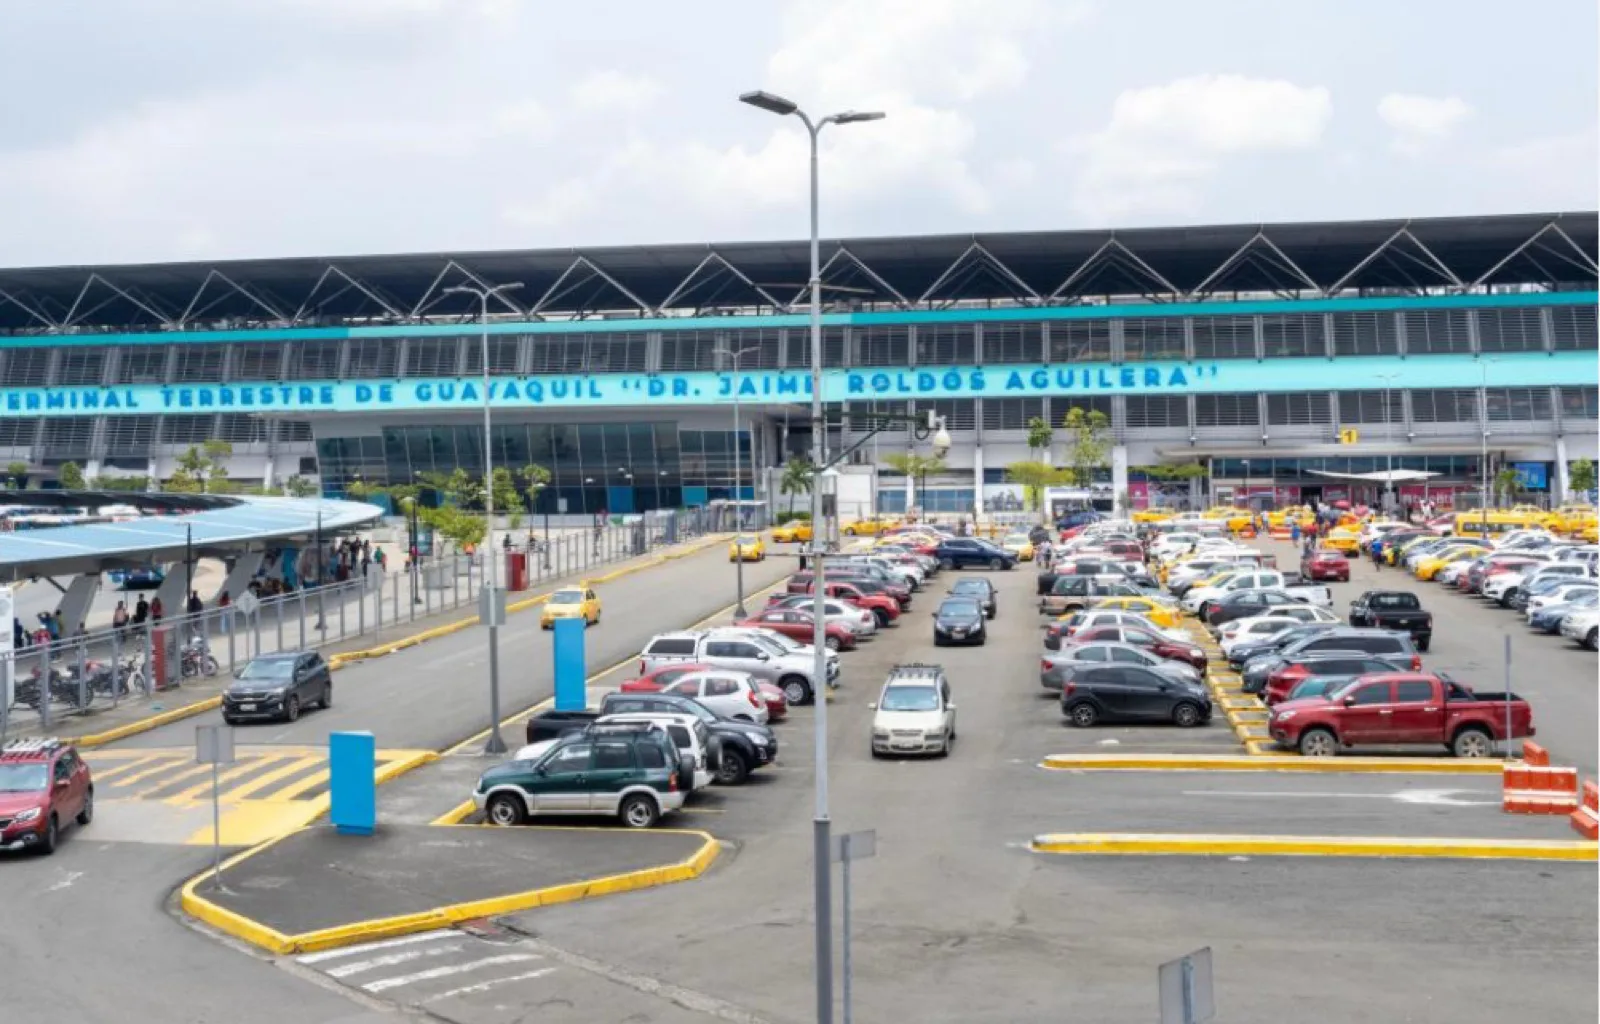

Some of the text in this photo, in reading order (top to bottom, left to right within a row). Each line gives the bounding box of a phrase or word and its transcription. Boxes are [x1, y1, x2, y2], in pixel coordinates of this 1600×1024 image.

[0, 391, 138, 410] ERMINAL
[161, 384, 334, 407] TERRESTRE
[356, 384, 393, 402] DE
